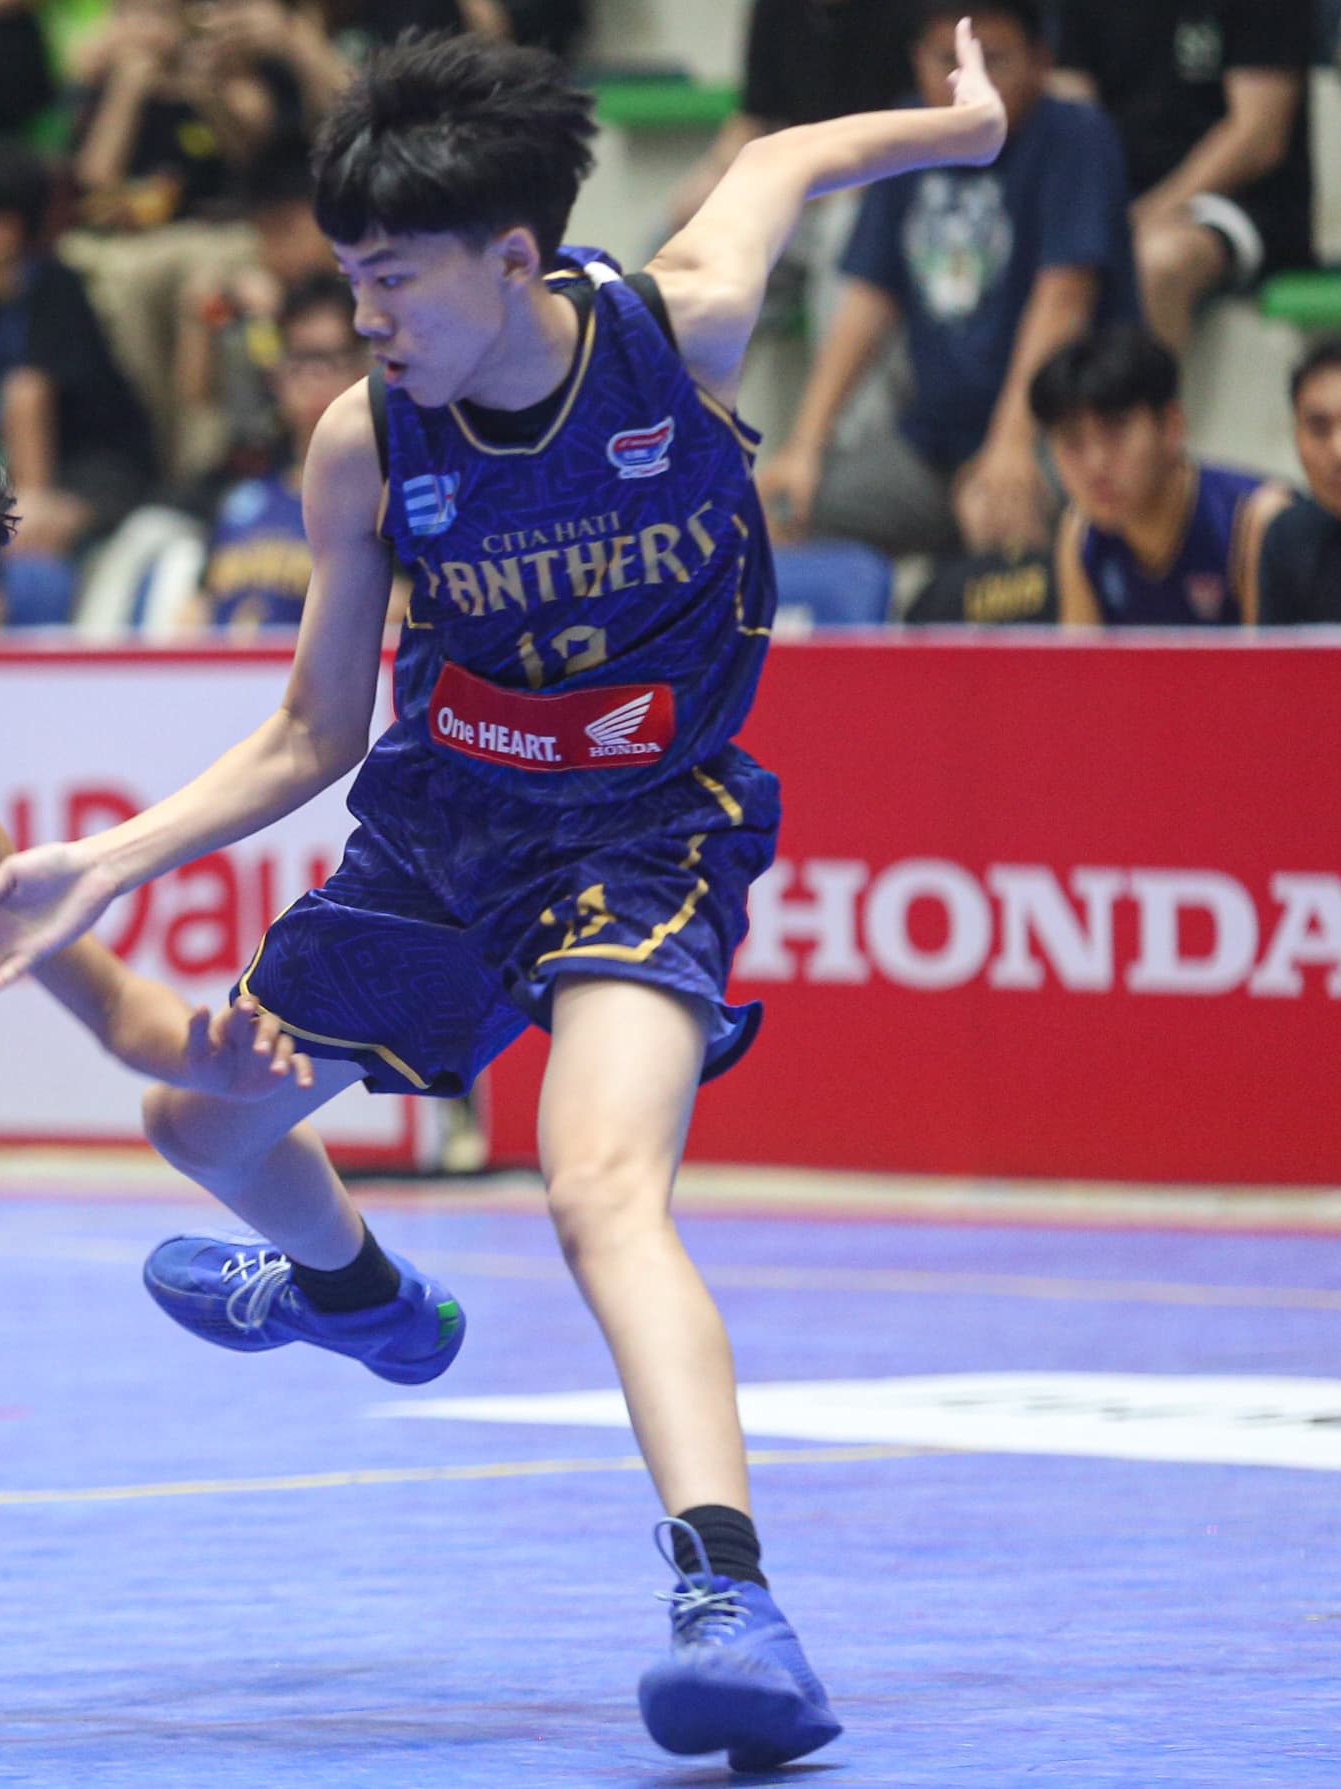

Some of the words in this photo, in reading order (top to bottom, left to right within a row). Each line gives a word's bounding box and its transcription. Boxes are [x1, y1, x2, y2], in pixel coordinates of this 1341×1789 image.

[482, 529, 548, 553] CITA
[554, 511, 621, 543] HATI
[437, 707, 475, 745] One
[478, 720, 563, 763] HEART.
[589, 741, 664, 758] HONDA
[733, 856, 1341, 999] HONDA
